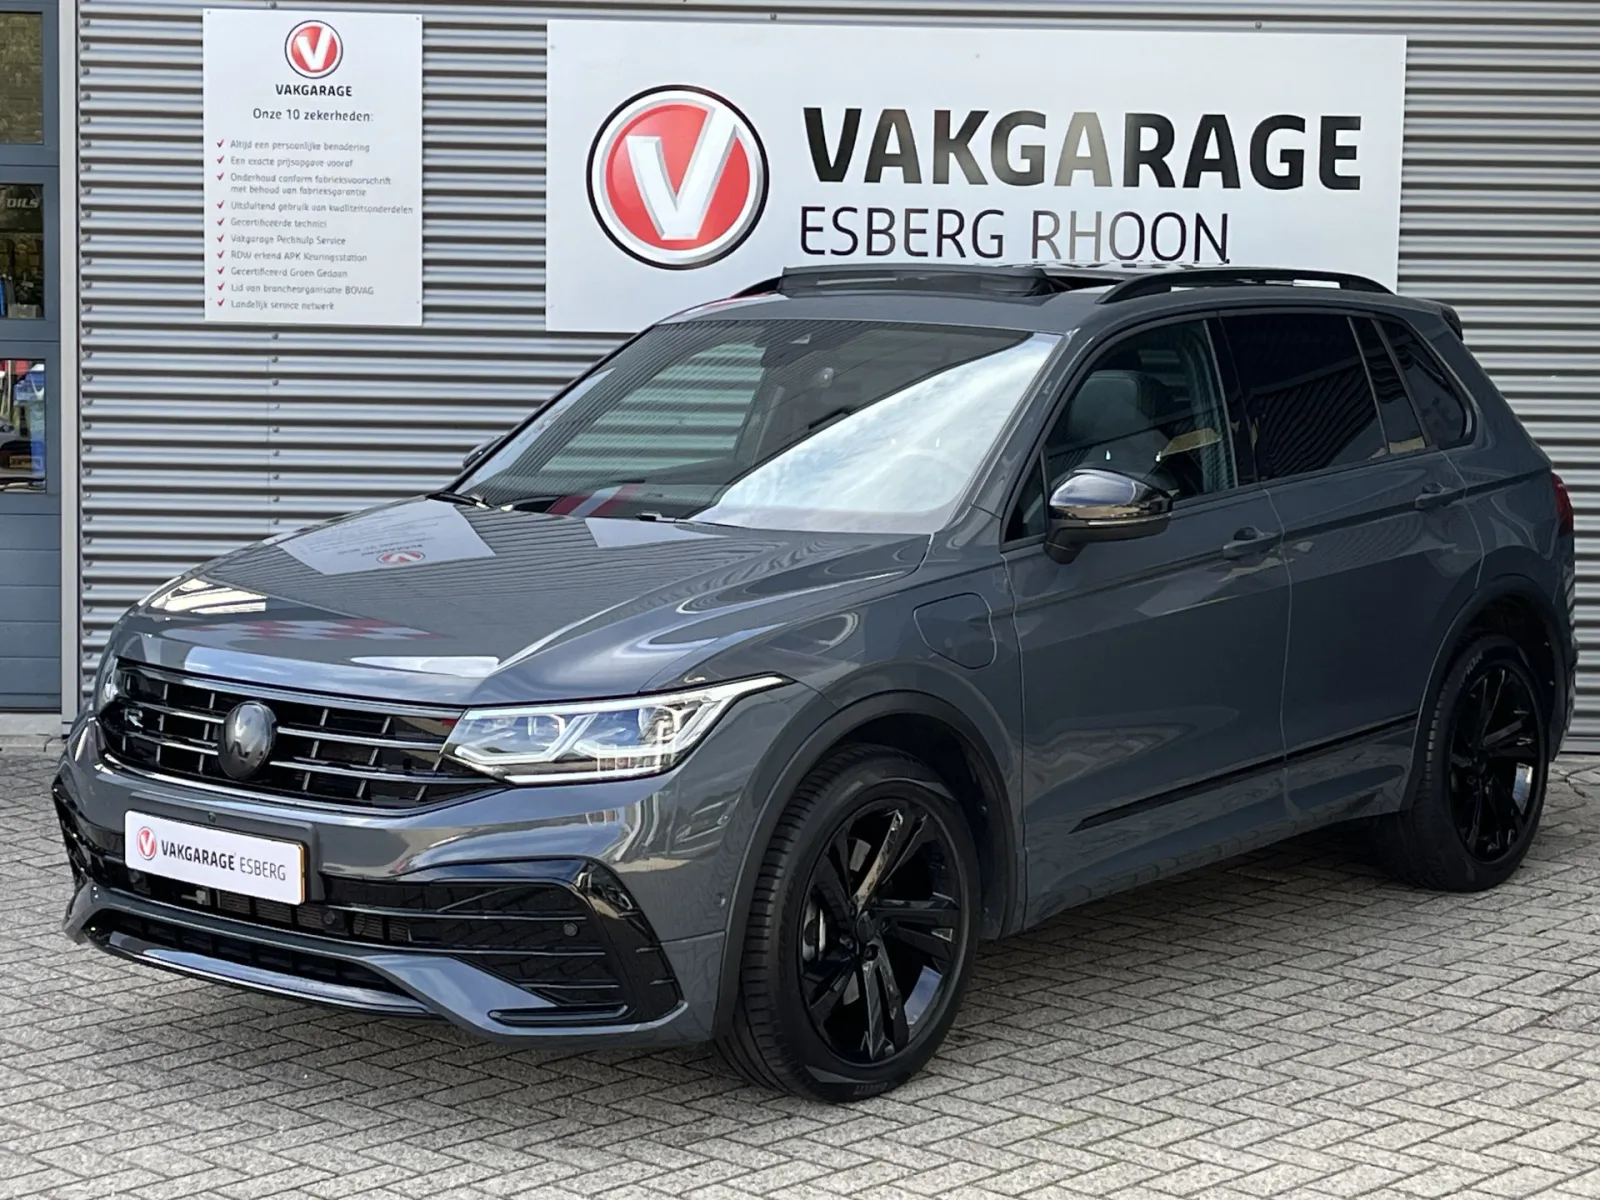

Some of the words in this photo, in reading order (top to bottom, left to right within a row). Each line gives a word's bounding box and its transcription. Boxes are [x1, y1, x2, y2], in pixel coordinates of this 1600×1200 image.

[275, 84, 353, 97] VAKGARAGE
[253, 108, 282, 120] Onze
[286, 109, 300, 120] 10
[304, 110, 374, 122] zekerheden:
[230, 140, 252, 150] Altijd
[272, 142, 320, 151] persoonlijke
[324, 143, 370, 152] benadering
[803, 107, 1362, 191] VAKGARAGE
[231, 156, 245, 165] Een
[277, 158, 324, 167] prijsopgave
[327, 159, 353, 167] vooraf
[231, 173, 275, 183] Onderhoud
[279, 175, 312, 183] conform
[315, 175, 391, 185] fabrieksvoorschrift
[250, 186, 279, 194] behoud
[300, 186, 366, 196] fabrieksgarantie
[7, 198, 39, 208] OILS
[231, 201, 275, 210] Uitsluitend
[278, 203, 309, 212] gebruik
[329, 204, 412, 214] kwaliteitsonderdelen
[231, 218, 291, 227] Gecertificeerde
[295, 219, 327, 228] technici
[231, 234, 274, 244] Vakgarage
[277, 235, 314, 245] Pechhulp
[316, 236, 346, 245] Service
[800, 206, 1004, 259] ESBERG
[1031, 209, 1231, 263] RHOON
[231, 251, 251, 259] RDW
[284, 252, 301, 260] APK
[303, 253, 367, 262] Keuringsstation
[231, 267, 288, 276] Gecertificeerd
[290, 269, 314, 277] Groen
[317, 269, 347, 278] Gedaan
[263, 284, 342, 295] brancheorganisatie
[345, 287, 374, 295] BOVAG
[231, 300, 268, 310] Landelijk
[161, 839, 235, 871] VAKGARAGE
[239, 856, 286, 881] ESBERG
